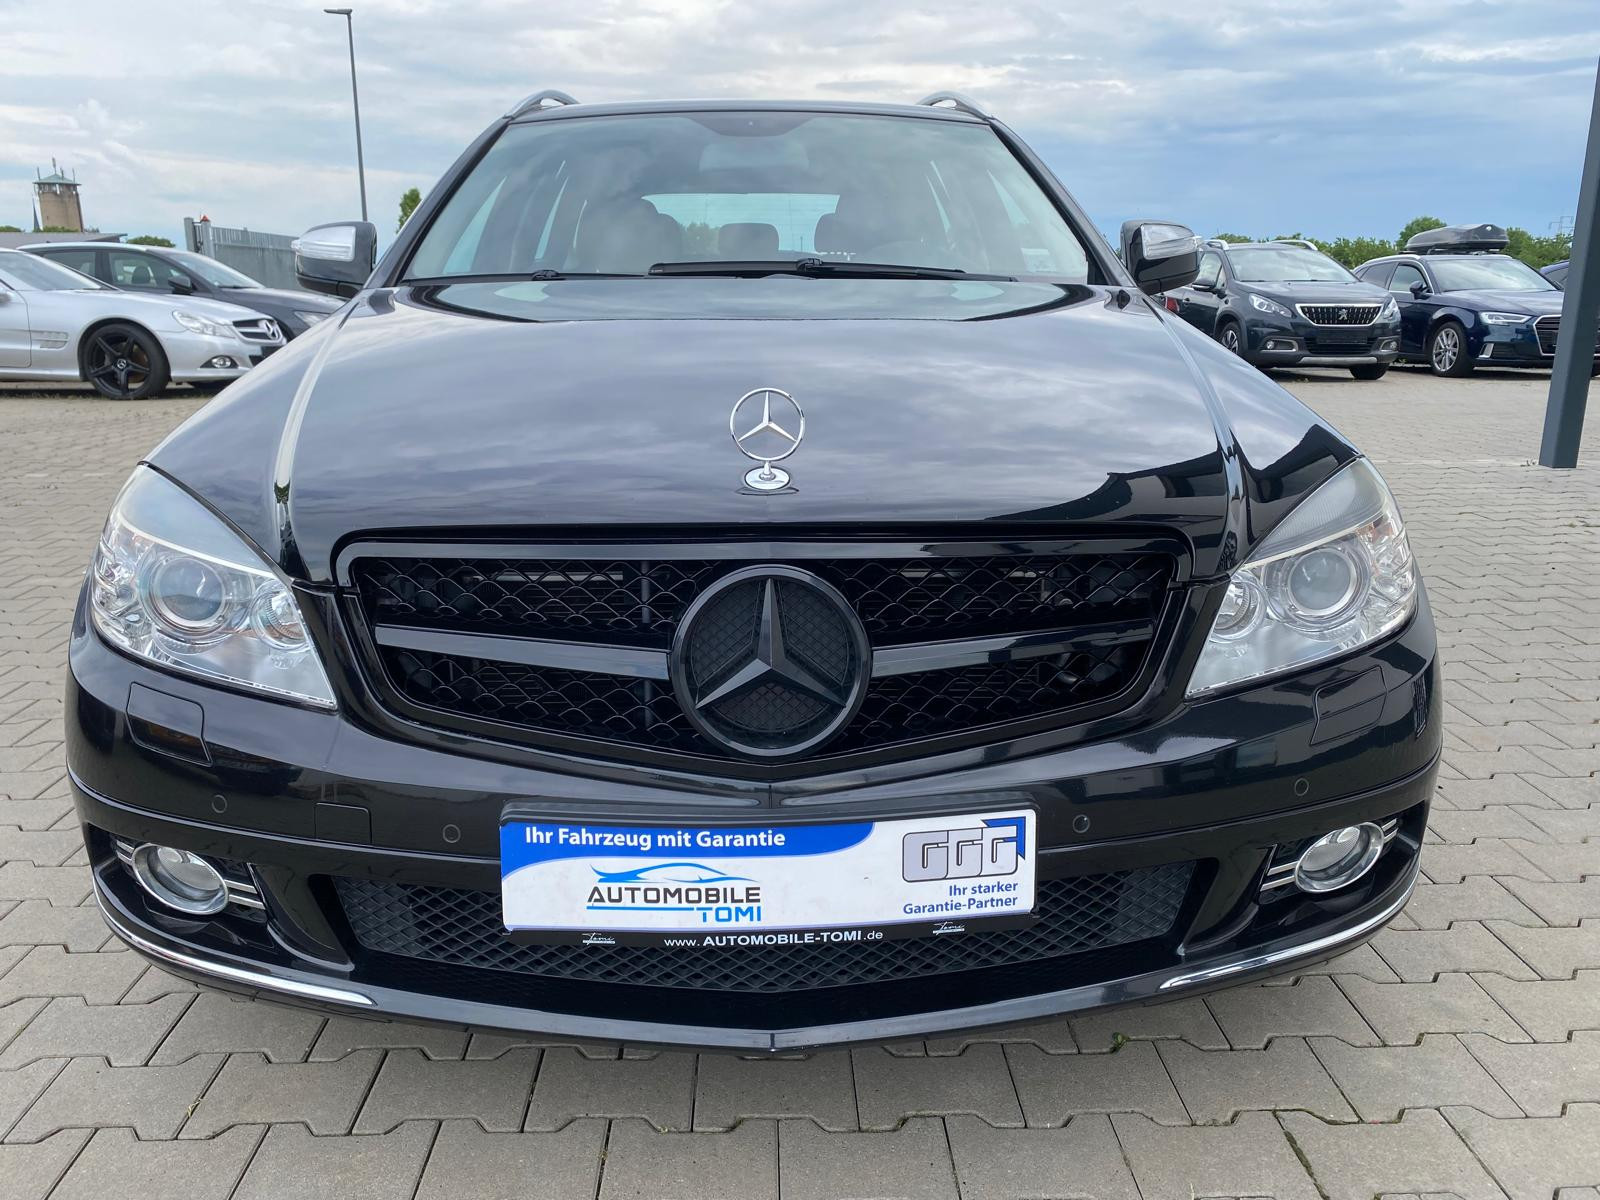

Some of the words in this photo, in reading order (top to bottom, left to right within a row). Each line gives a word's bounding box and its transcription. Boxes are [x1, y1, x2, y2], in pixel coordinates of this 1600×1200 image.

[525, 827, 551, 844] Ihr
[558, 828, 651, 851] Fahrzeug
[657, 830, 691, 847] mit
[696, 829, 786, 848] Garantie
[587, 886, 761, 904] AUTOMOBILE
[949, 885, 967, 897] Ihr
[971, 881, 1018, 895] starker
[903, 895, 1018, 915] Garantie-Partner
[696, 906, 761, 923] TOMI
